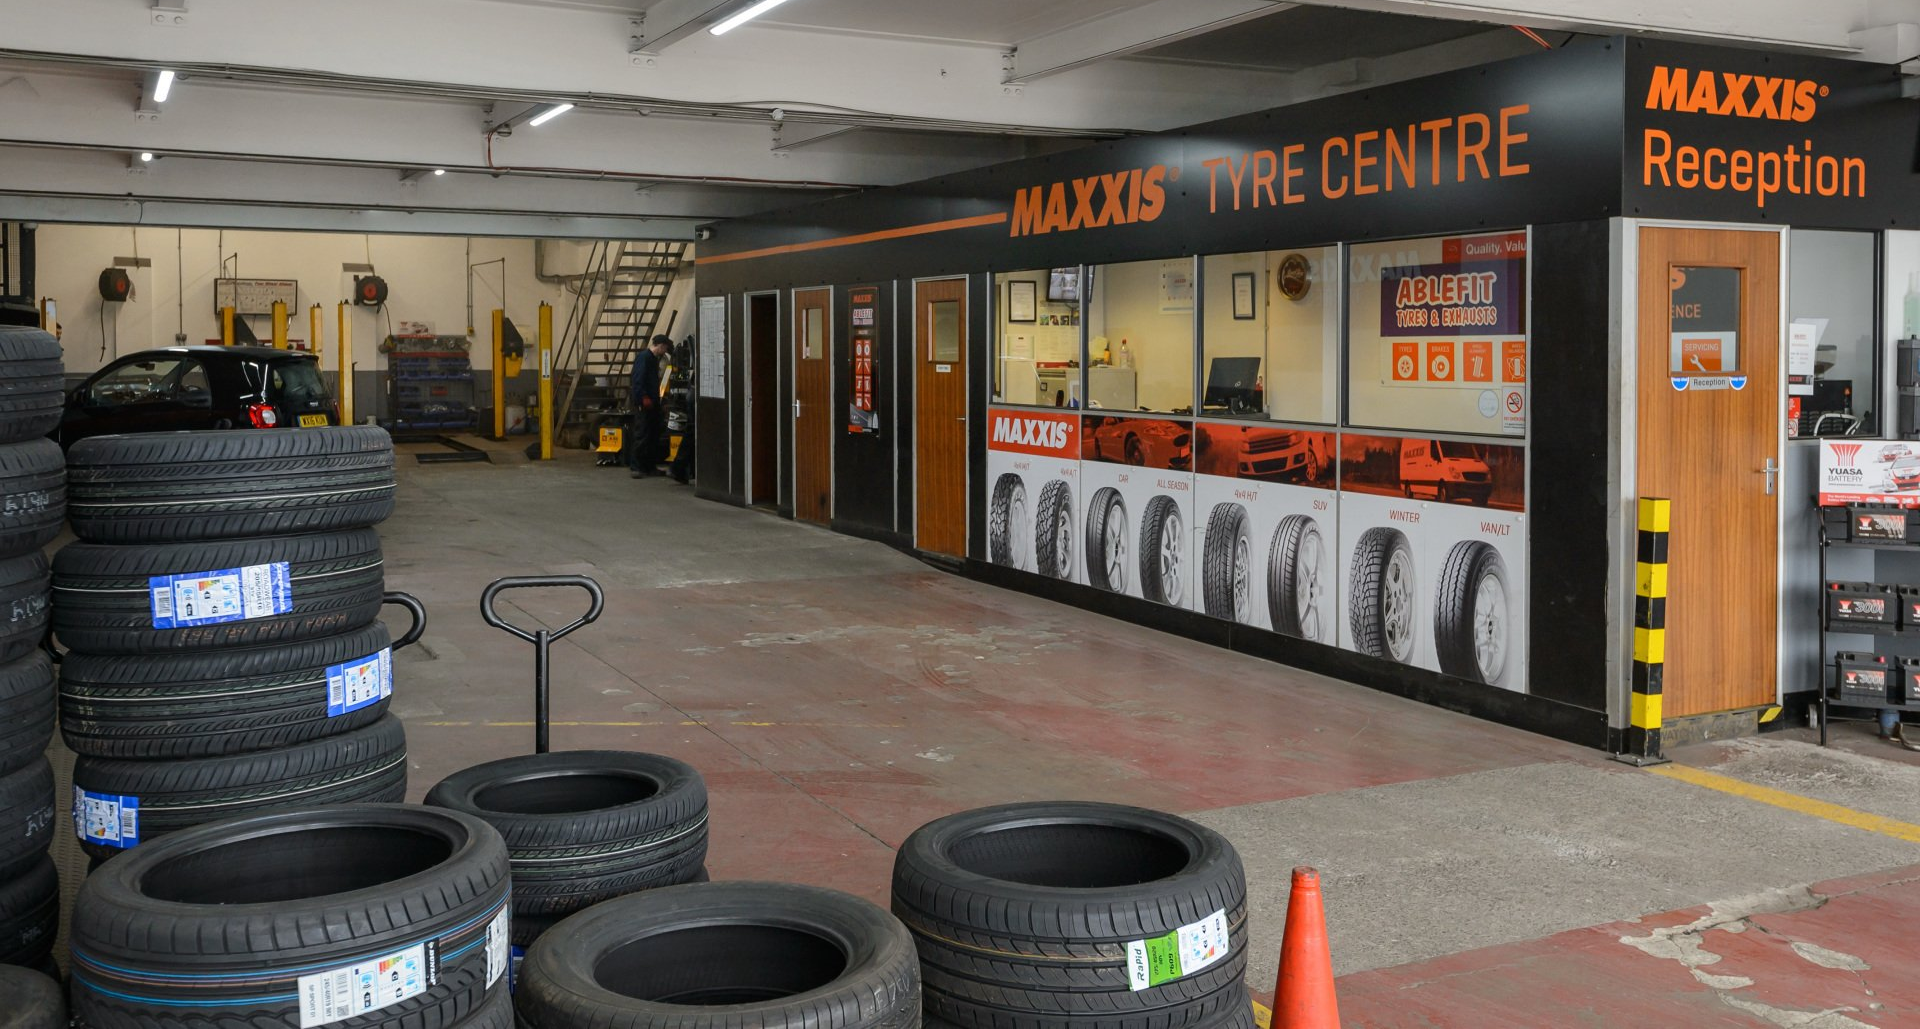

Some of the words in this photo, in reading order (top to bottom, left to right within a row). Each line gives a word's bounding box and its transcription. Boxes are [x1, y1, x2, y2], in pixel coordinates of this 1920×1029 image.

[1645, 65, 1818, 122] MAXXIS
[1009, 164, 1167, 237] MAXXIS
[1202, 143, 1305, 214] TYRE
[1321, 104, 1531, 199] CENTRE
[1643, 128, 1866, 208] Reception
[1395, 271, 1498, 309] ABLEFIT
[1396, 308, 1428, 328] TYRES
[1430, 309, 1440, 327] &
[1441, 305, 1498, 328] EXHAUSTS
[1431, 345, 1450, 353] BRAKES
[1684, 343, 1719, 352] SERVICING
[1693, 379, 1726, 388] Reception
[993, 417, 1068, 449] MAXXIS
[1829, 467, 1863, 475] YUASA
[1118, 473, 1129, 484] CAR
[1156, 478, 1166, 489] ALL
[1167, 480, 1189, 492] SEASON
[1828, 475, 1863, 483] BATTERY
[1234, 489, 1246, 499] 4x4
[1246, 491, 1258, 502] H/T
[1312, 499, 1328, 511] SUV
[1389, 509, 1421, 524] WINTER
[1479, 521, 1511, 537] VAN/LT
[428, 949, 437, 986] DUNLOP
